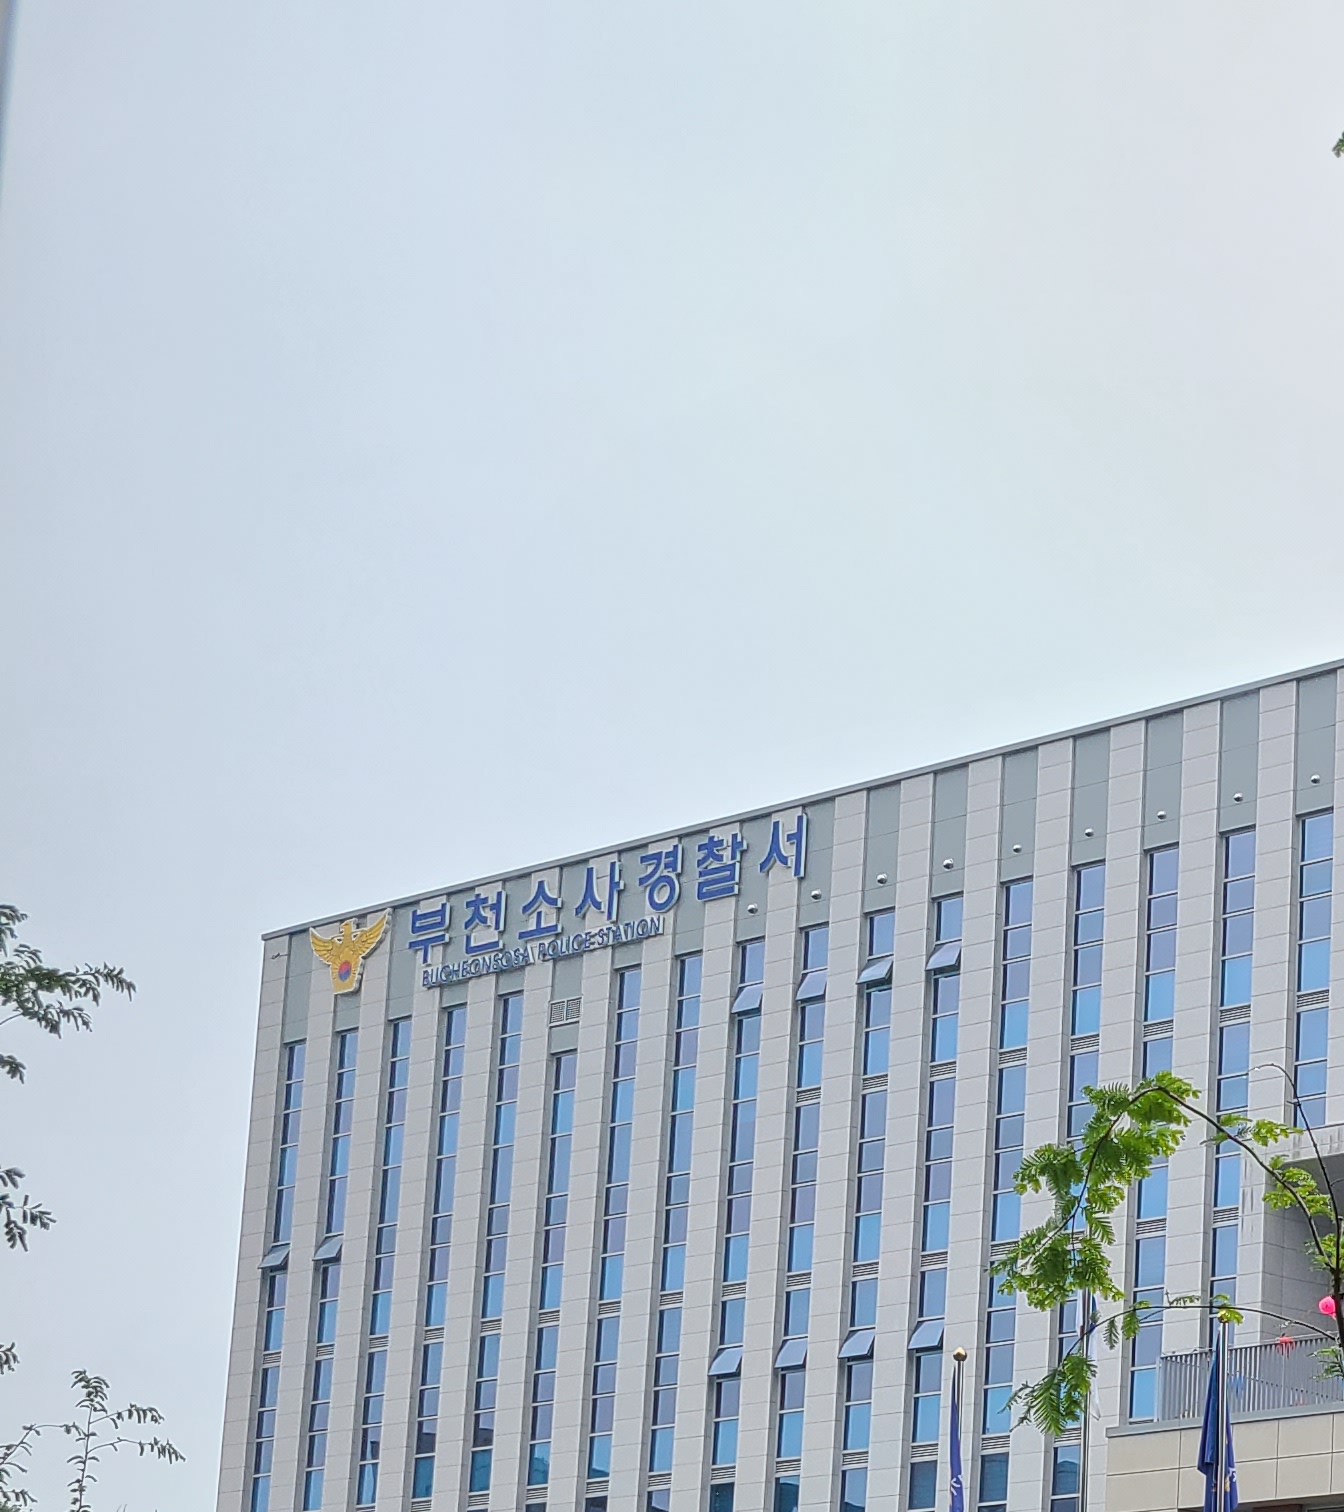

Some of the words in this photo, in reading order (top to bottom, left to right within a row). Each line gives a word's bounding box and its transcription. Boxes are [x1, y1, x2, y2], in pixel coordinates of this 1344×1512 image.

[407, 812, 809, 965] 부천소사경찰서
[422, 944, 533, 989] BUCHEONSOSA
[536, 930, 596, 961] POLICE
[597, 915, 665, 947] STATION
